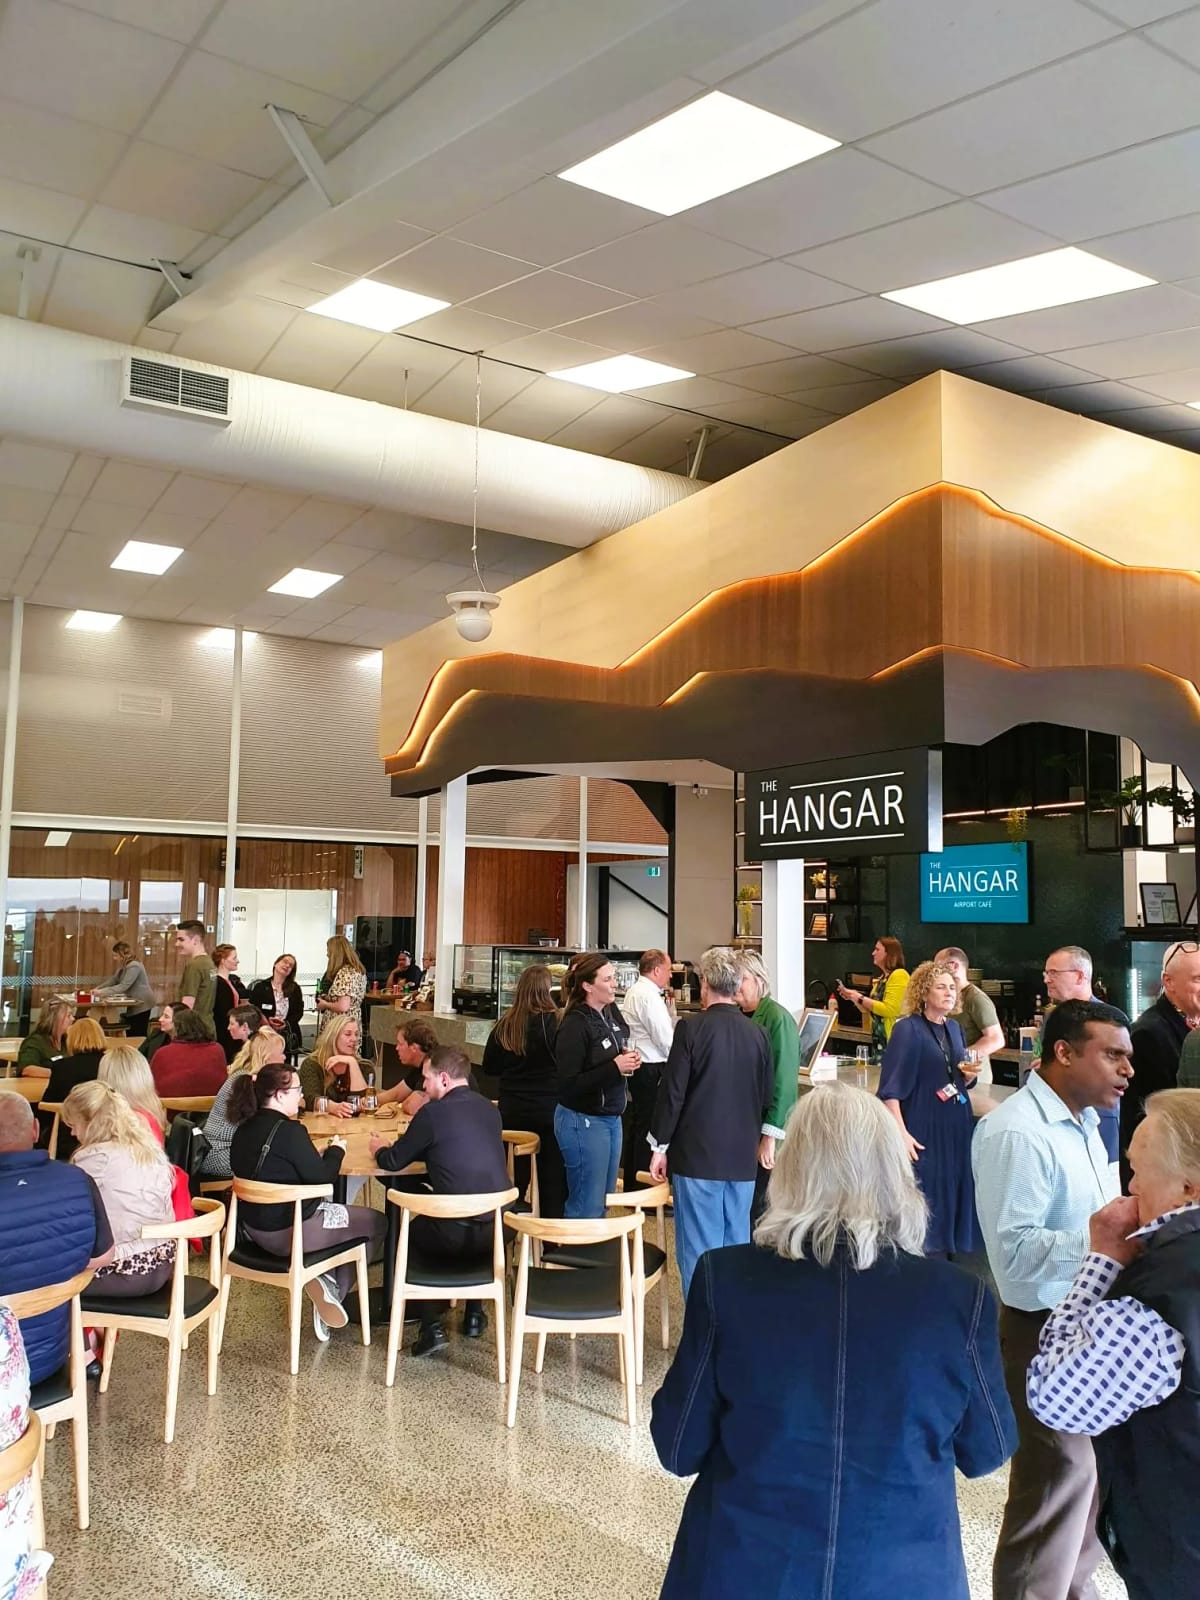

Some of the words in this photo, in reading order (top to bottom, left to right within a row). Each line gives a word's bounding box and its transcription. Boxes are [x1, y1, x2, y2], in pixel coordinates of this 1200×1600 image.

[760, 780, 777, 793] THE
[759, 784, 904, 836] HANGAR
[929, 869, 1018, 893] HANGAR
[978, 900, 992, 908] CAFÉ
